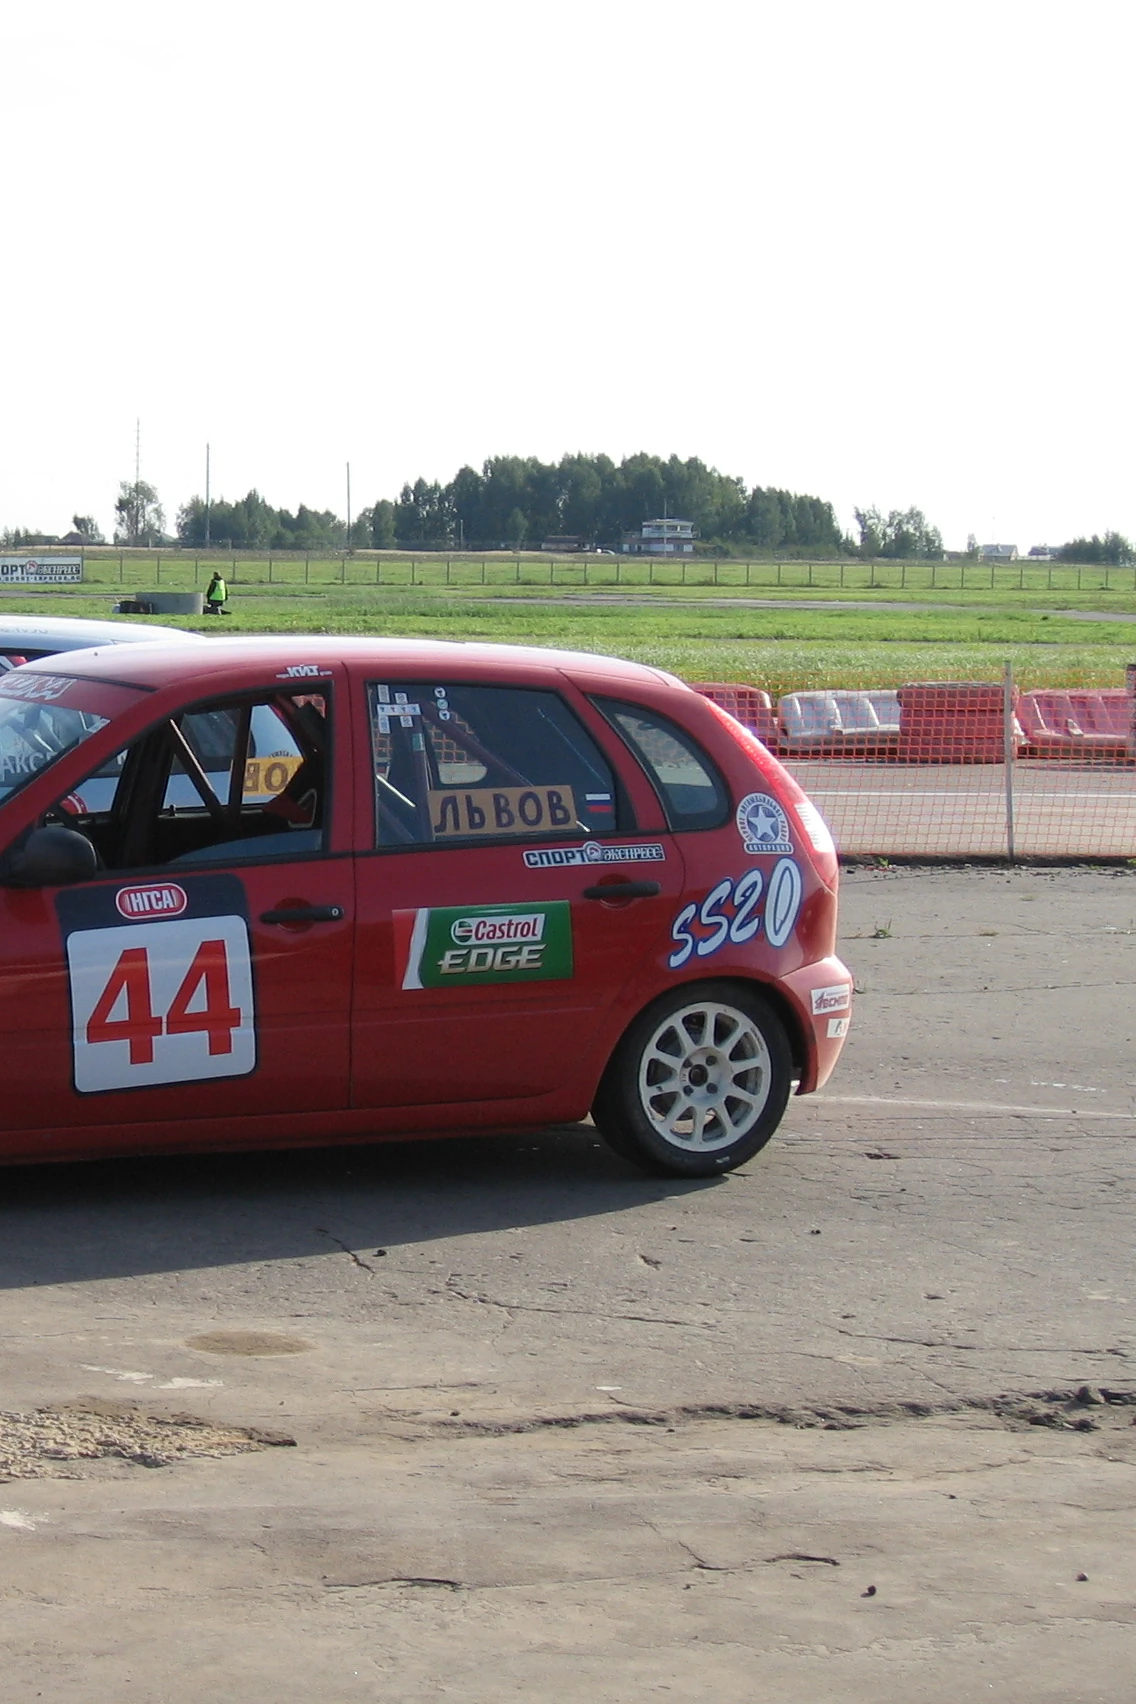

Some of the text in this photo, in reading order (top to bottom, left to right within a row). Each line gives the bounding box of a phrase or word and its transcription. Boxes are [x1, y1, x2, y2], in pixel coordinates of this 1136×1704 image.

[434, 790, 571, 833] ЛЬВОВ
[526, 845, 663, 866] СПОРТ ЭКСПРЕСС
[474, 917, 538, 941] Castrol
[437, 944, 547, 975] EDGE
[86, 939, 241, 1065] 44
